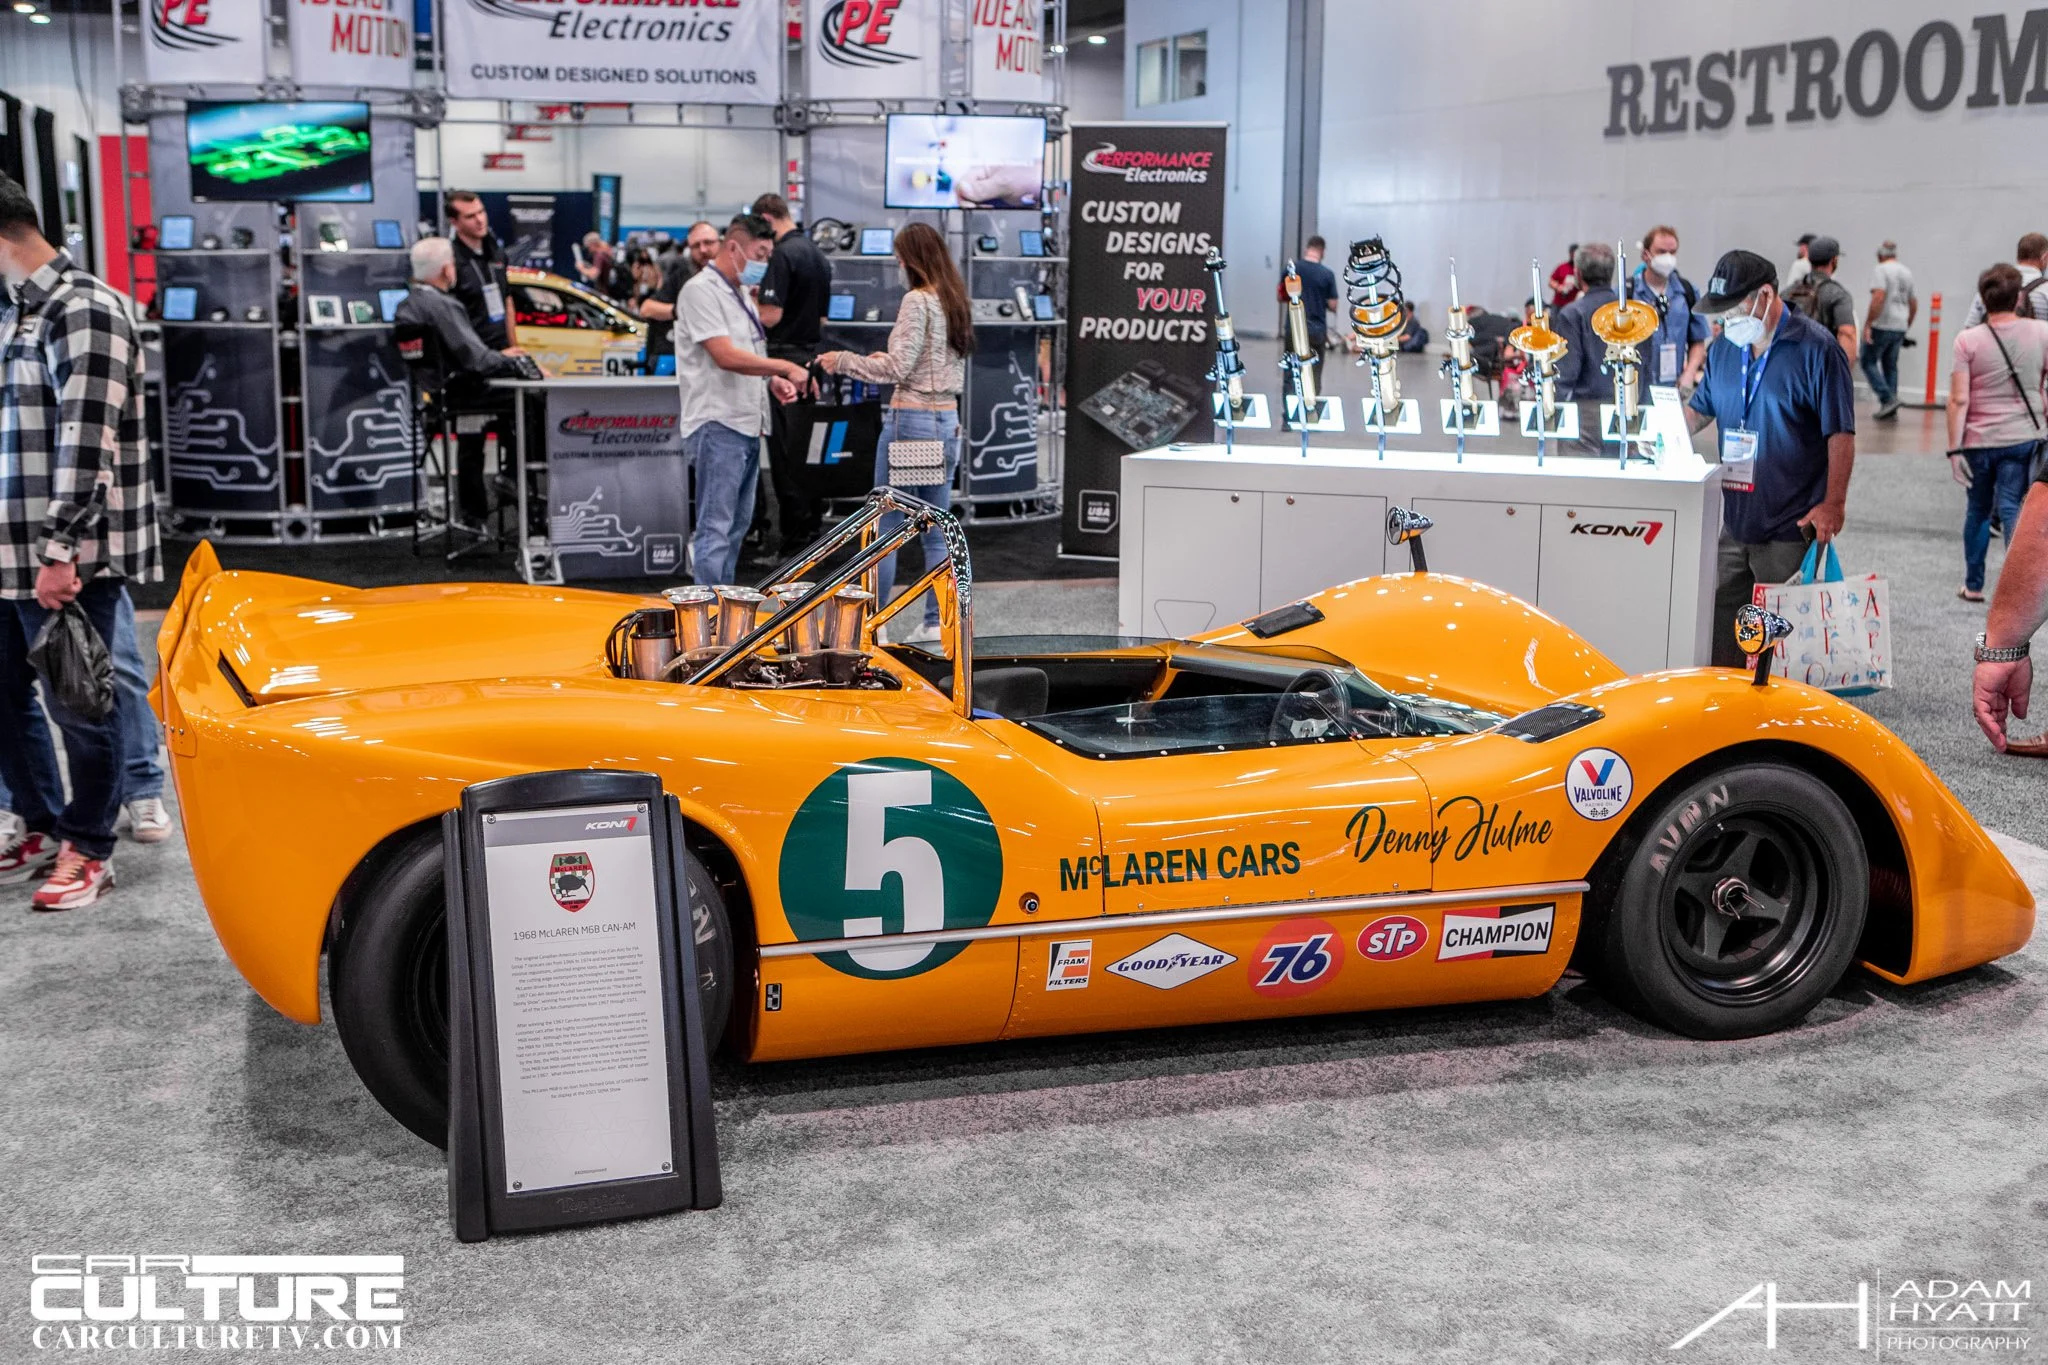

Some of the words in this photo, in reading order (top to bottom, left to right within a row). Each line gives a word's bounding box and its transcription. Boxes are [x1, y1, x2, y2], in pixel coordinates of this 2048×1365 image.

[549, 10, 734, 42] Electronics
[836, 0, 901, 46] PE
[471, 63, 548, 81] CUSTOM
[556, 67, 648, 84] DESIGNED
[655, 71, 757, 86] SOLUTIONS
[1604, 8, 2048, 138] RESTROOM
[1093, 151, 1213, 169] PERFORMANCE
[1124, 167, 1208, 183] Electronics
[1081, 200, 1182, 224] CUSTOM
[1105, 230, 1212, 255] DESIGNS
[1123, 261, 1165, 281] FOR
[1136, 287, 1206, 313] YOUR
[1078, 316, 1208, 342] PRODUCTS
[592, 429, 672, 444] Electronics
[1574, 785, 1622, 804] VALVOLINE
[1345, 805, 1451, 863] Denny
[1437, 795, 1553, 862] Hulme
[1650, 785, 1729, 877] AVON
[844, 770, 945, 971] 5
[1217, 841, 1301, 879] CARS
[513, 930, 538, 941] 1968
[539, 927, 579, 938] McLAREN
[581, 924, 601, 935] M6B
[602, 921, 637, 933] CAN-AM
[1367, 923, 1417, 955] STP
[1446, 921, 1550, 948] CHAMPION
[1057, 957, 1086, 966] FRAM
[1256, 933, 1334, 987] 76
[1049, 977, 1088, 987] FILTERS
